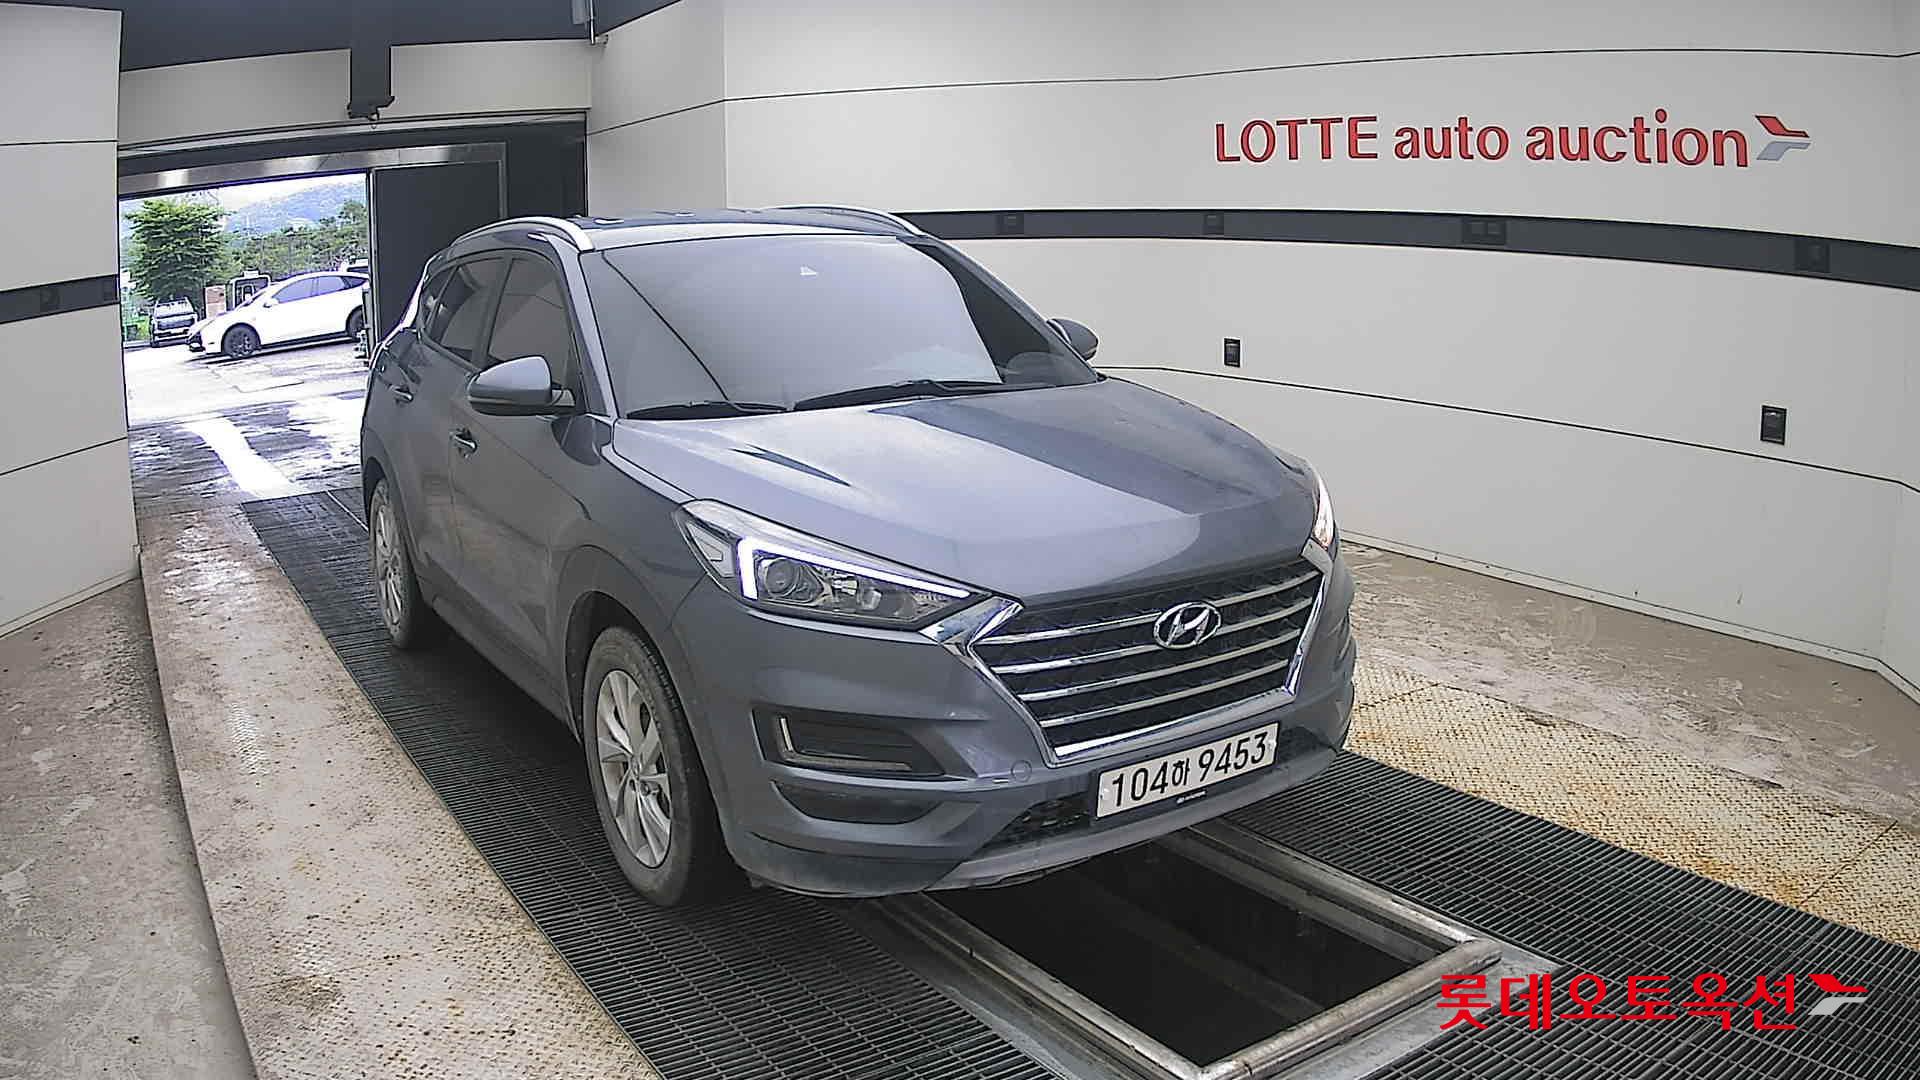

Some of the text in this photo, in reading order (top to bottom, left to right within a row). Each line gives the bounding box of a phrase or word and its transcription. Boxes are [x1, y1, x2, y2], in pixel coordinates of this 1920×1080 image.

[1215, 108, 1749, 168] LOTTE auto auction
[1111, 731, 1268, 807] 104하 9453
